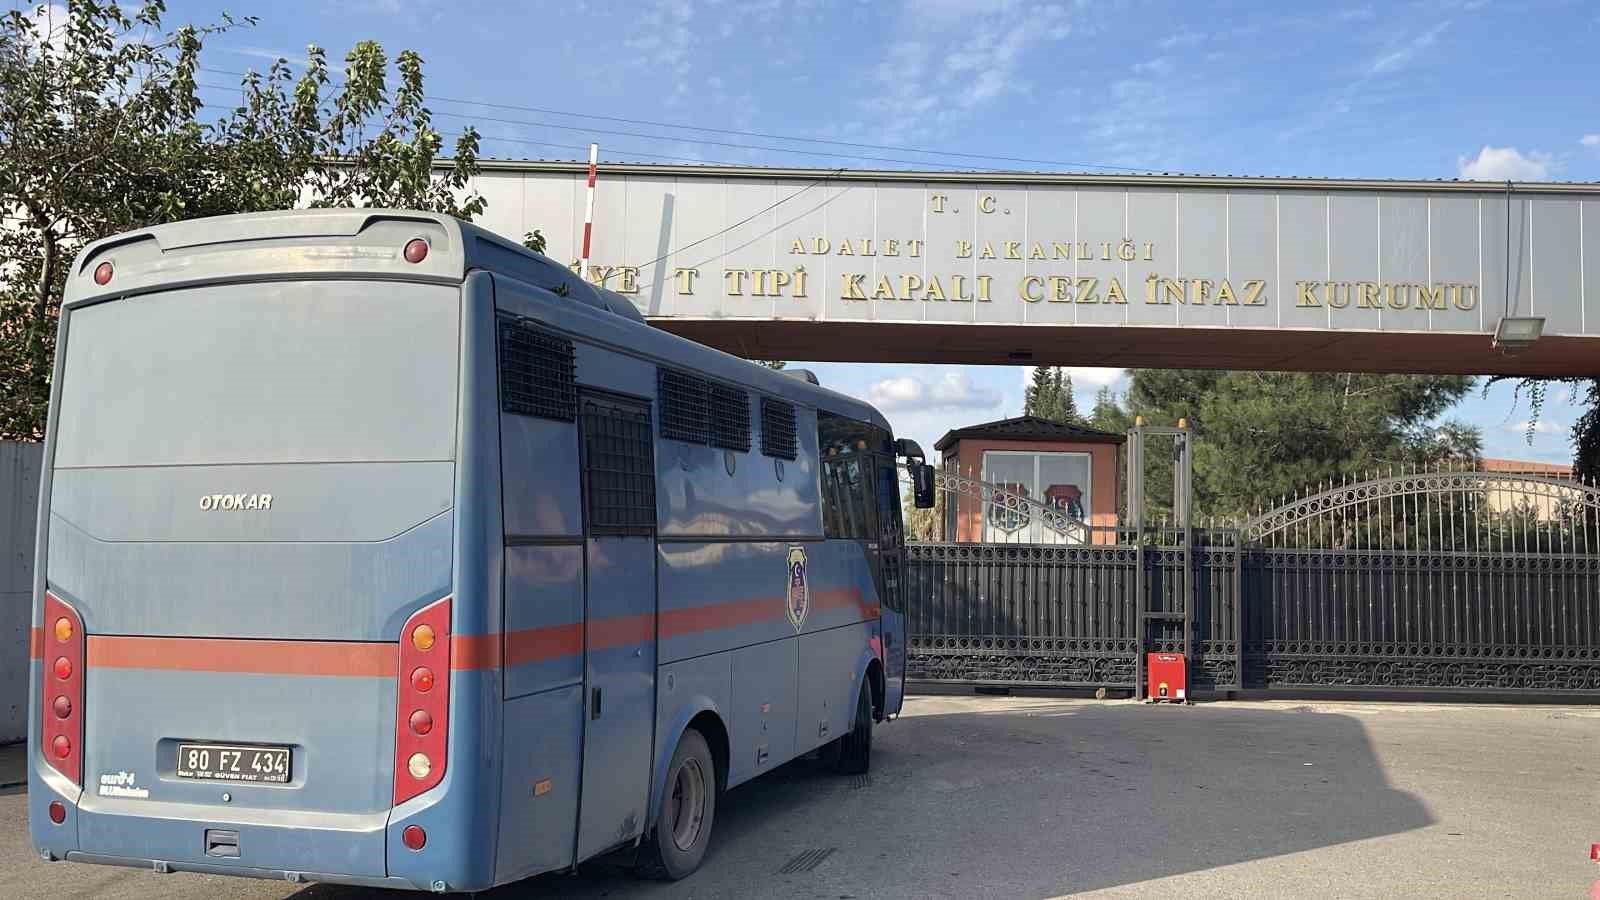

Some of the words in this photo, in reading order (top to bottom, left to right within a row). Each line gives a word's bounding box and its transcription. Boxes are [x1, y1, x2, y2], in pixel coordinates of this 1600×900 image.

[788, 238, 923, 258] ADALET
[956, 238, 1154, 262] BAKANLIĞI
[675, 267, 699, 297] T
[724, 264, 808, 298] TIPİ
[841, 271, 993, 302] KAPALI
[1017, 275, 1128, 305] CEZA
[1145, 272, 1267, 306] İNFAZ
[1295, 280, 1478, 310] KURUMU
[199, 493, 273, 511] OTOKAR
[188, 749, 209, 770] 80
[219, 751, 242, 772] FZ
[251, 752, 284, 774] 434
